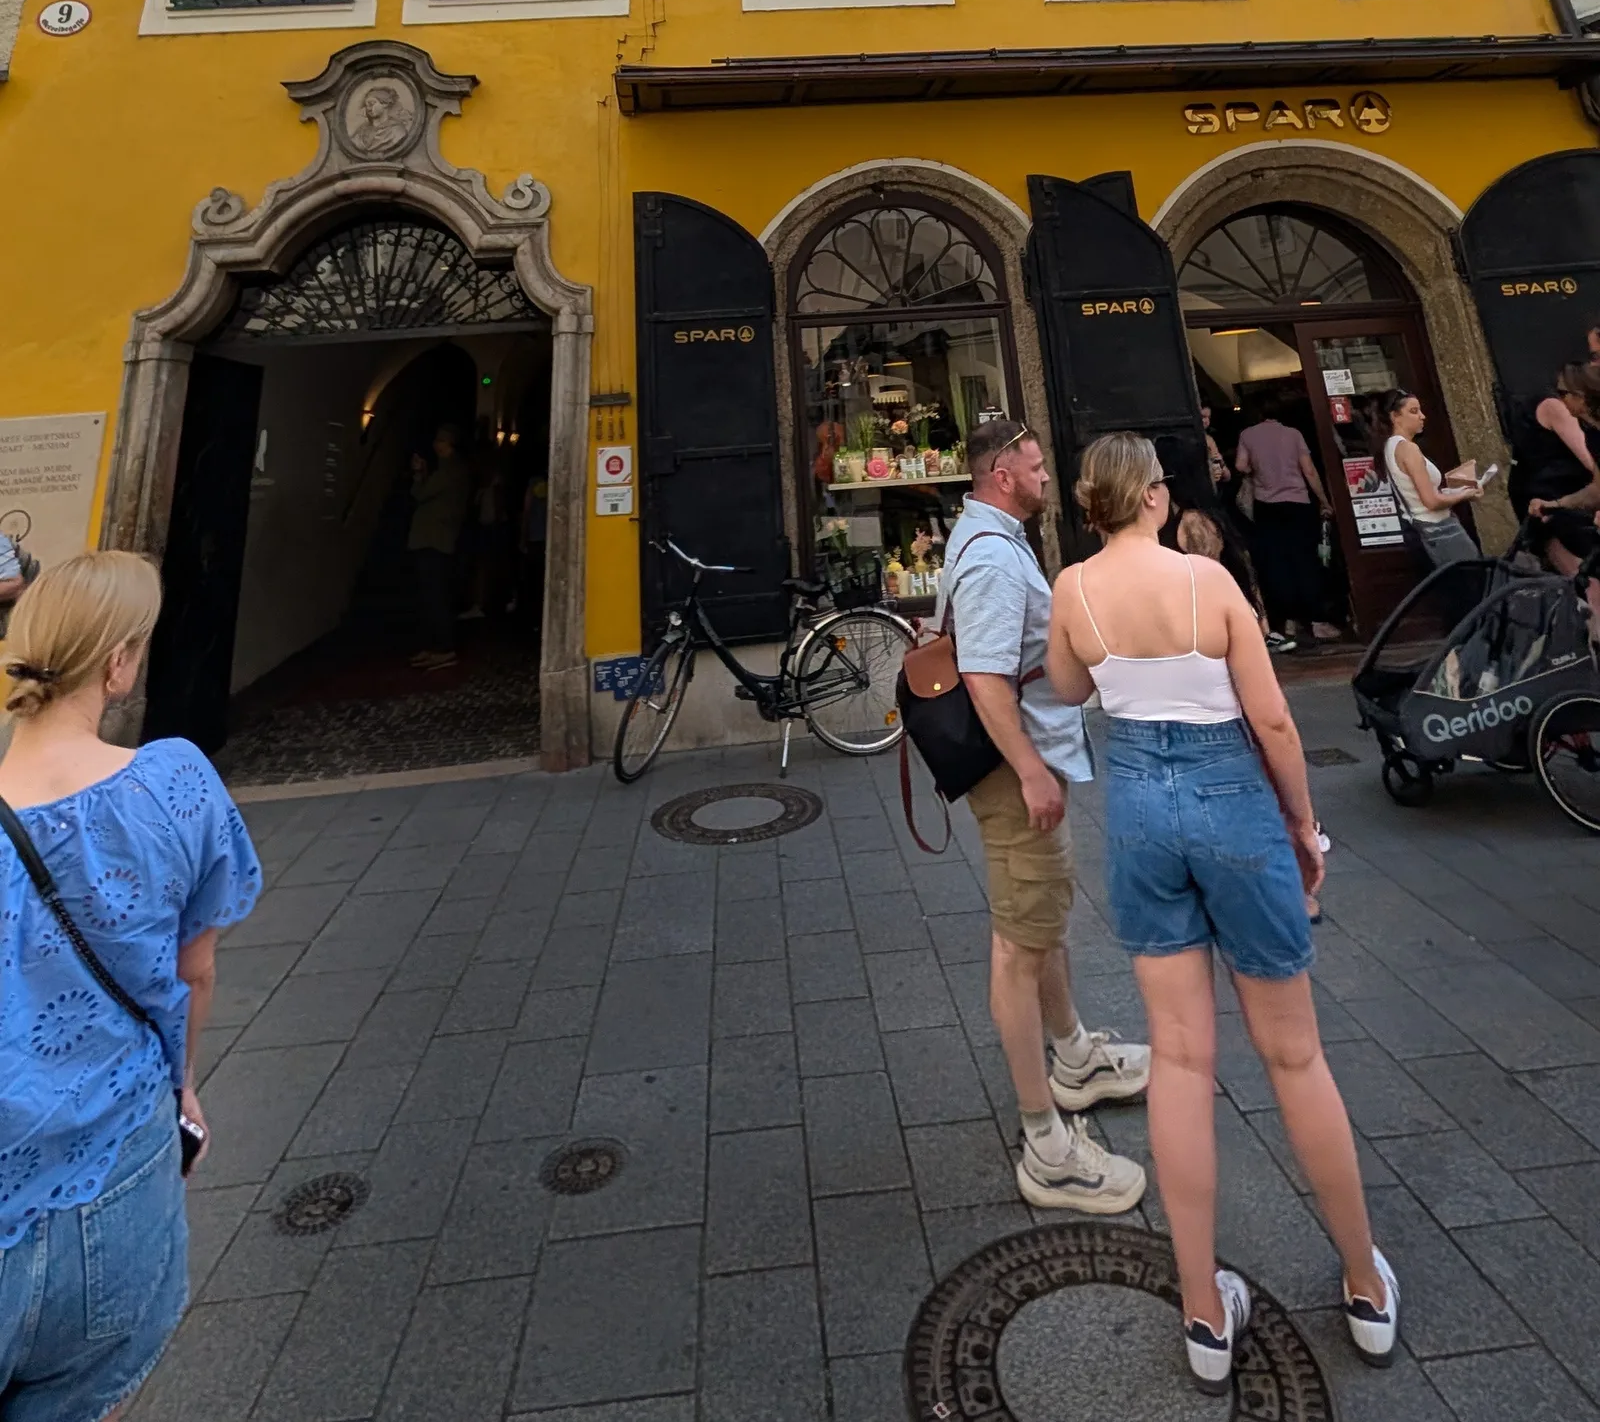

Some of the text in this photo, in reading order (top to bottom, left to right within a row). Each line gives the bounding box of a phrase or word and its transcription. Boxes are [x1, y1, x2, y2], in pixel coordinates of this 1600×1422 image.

[57, 3, 73, 24] 9
[1184, 98, 1344, 134] SPAR
[1501, 281, 1560, 296] SPAR
[1081, 301, 1138, 316] SPAR
[674, 329, 736, 344] SPAR
[1422, 695, 1533, 742] Qeridoo
